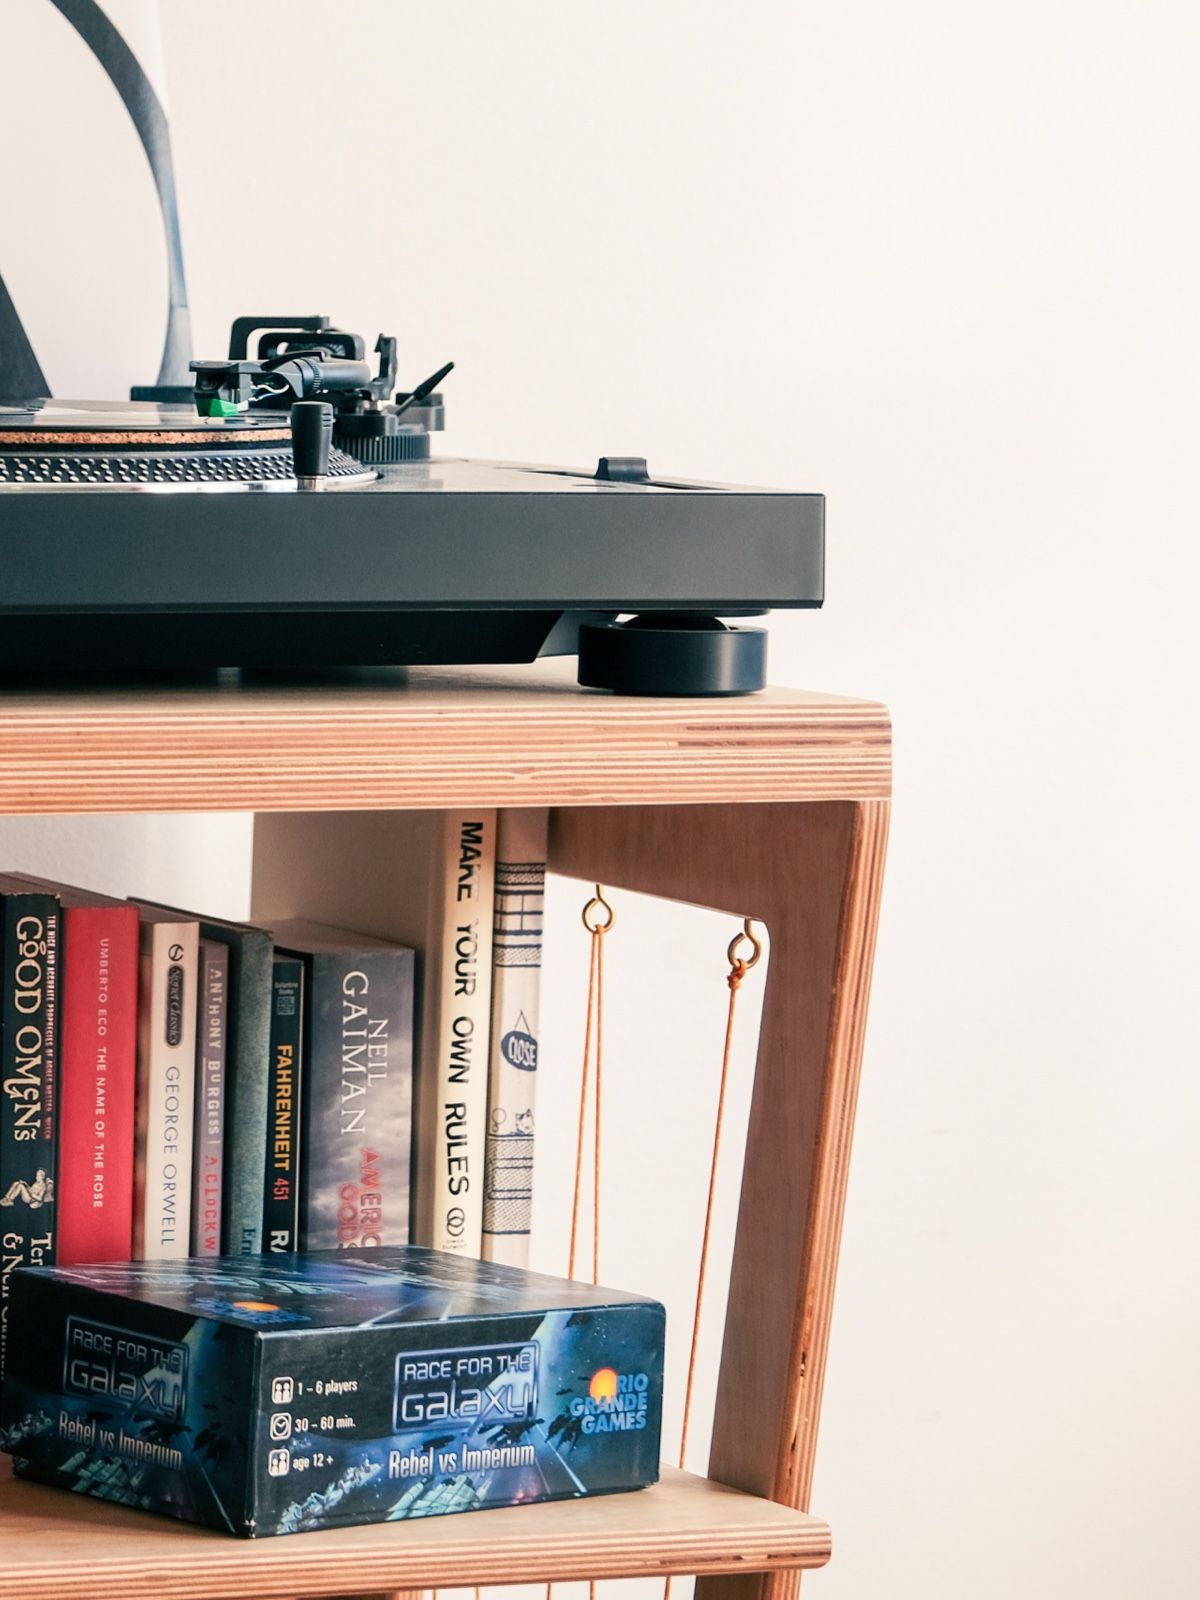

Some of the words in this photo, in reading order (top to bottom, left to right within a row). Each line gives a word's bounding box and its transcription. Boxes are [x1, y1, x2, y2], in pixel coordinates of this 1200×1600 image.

[456, 821, 484, 903] MAKE
[47, 915, 56, 928] THE
[47, 930, 56, 947] NICE
[15, 915, 47, 1014] GOOD
[47, 950, 56, 965] AND
[99, 938, 110, 1003] UMBERTO
[453, 919, 480, 997] YOUR
[97, 1008, 107, 1036] ECO
[168, 1001, 182, 1044] Classics
[209, 969, 223, 1050] ANTHONY
[96, 1046, 107, 1071] THE
[341, 970, 369, 1135] GAIMAN
[367, 1018, 389, 1087] NEIL
[448, 1016, 475, 1084] OWN
[95, 1077, 106, 1115] NAME
[162, 1065, 181, 1154] GEORGE
[274, 1045, 293, 1171] FAHRENHEIT
[94, 1121, 105, 1138] OF
[94, 1144, 104, 1169] THE
[444, 1103, 470, 1196] RULES
[93, 1174, 103, 1208] ROSE
[160, 1163, 178, 1246] ORWELL
[273, 1177, 289, 1200] 451
[116, 1339, 147, 1363] FOR
[151, 1347, 183, 1373] THE
[456, 1356, 492, 1377] FOR
[497, 1352, 531, 1373] THE
[298, 1382, 303, 1396] 1
[315, 1380, 323, 1394] 6
[325, 1379, 358, 1396] players
[617, 1373, 649, 1393] RIO
[570, 1391, 648, 1417] GRANDE
[294, 1418, 309, 1432] 30
[320, 1415, 334, 1430] 60
[335, 1414, 357, 1429] min.
[581, 1410, 647, 1434] GAMES
[59, 1410, 96, 1442] Rebel
[100, 1430, 115, 1451] vs
[119, 1426, 182, 1471] Imperium
[292, 1457, 310, 1472] age
[312, 1453, 324, 1467] 12
[388, 1447, 434, 1479] Rebel
[438, 1451, 458, 1473] vs
[462, 1440, 535, 1478] Imperium
